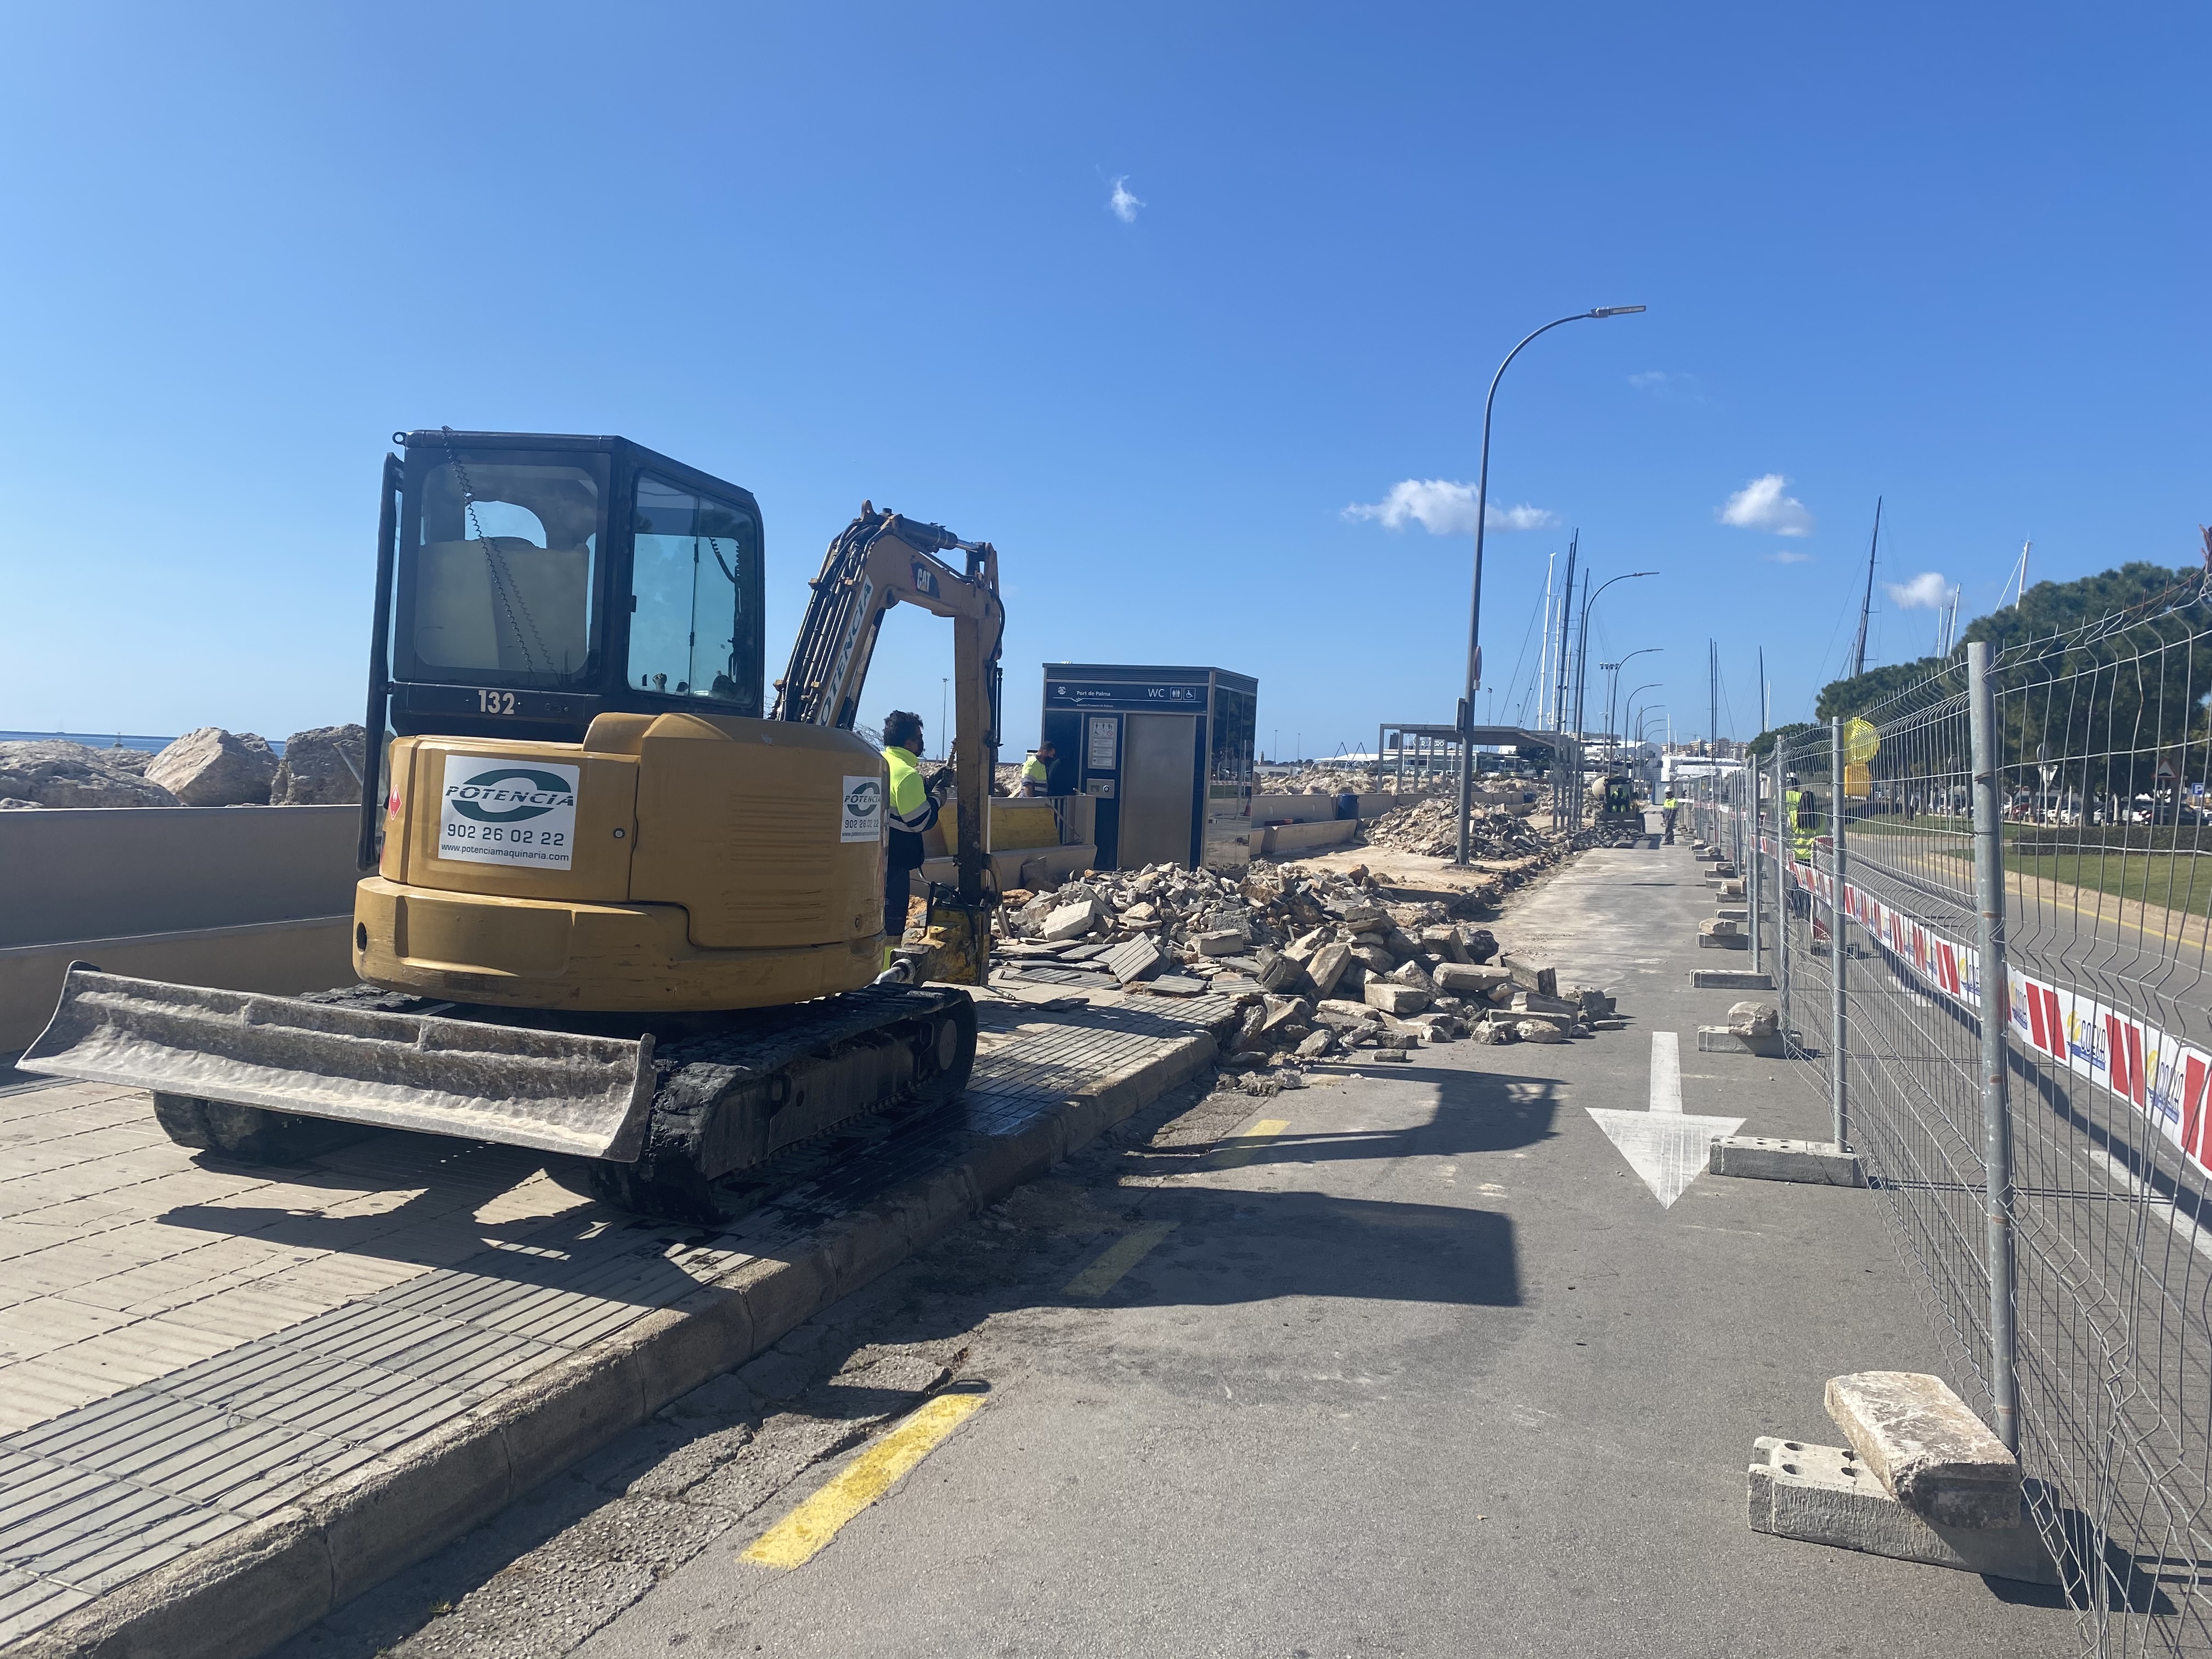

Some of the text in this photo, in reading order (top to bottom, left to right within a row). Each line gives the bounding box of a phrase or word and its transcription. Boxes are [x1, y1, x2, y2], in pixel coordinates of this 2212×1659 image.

[917, 568, 932, 592] CAT
[820, 583, 872, 726] OTENCIA
[1148, 688, 1165, 697] WC
[478, 690, 515, 715] 132
[445, 786, 574, 806] POTENCIA
[2195, 785, 2204, 794] P
[844, 795, 881, 803] POTENCIA
[845, 819, 879, 828] 902 26 02 22
[447, 823, 565, 846] 902 26 02 22
[441, 844, 569, 861] www.potenciamaquinaria.com
